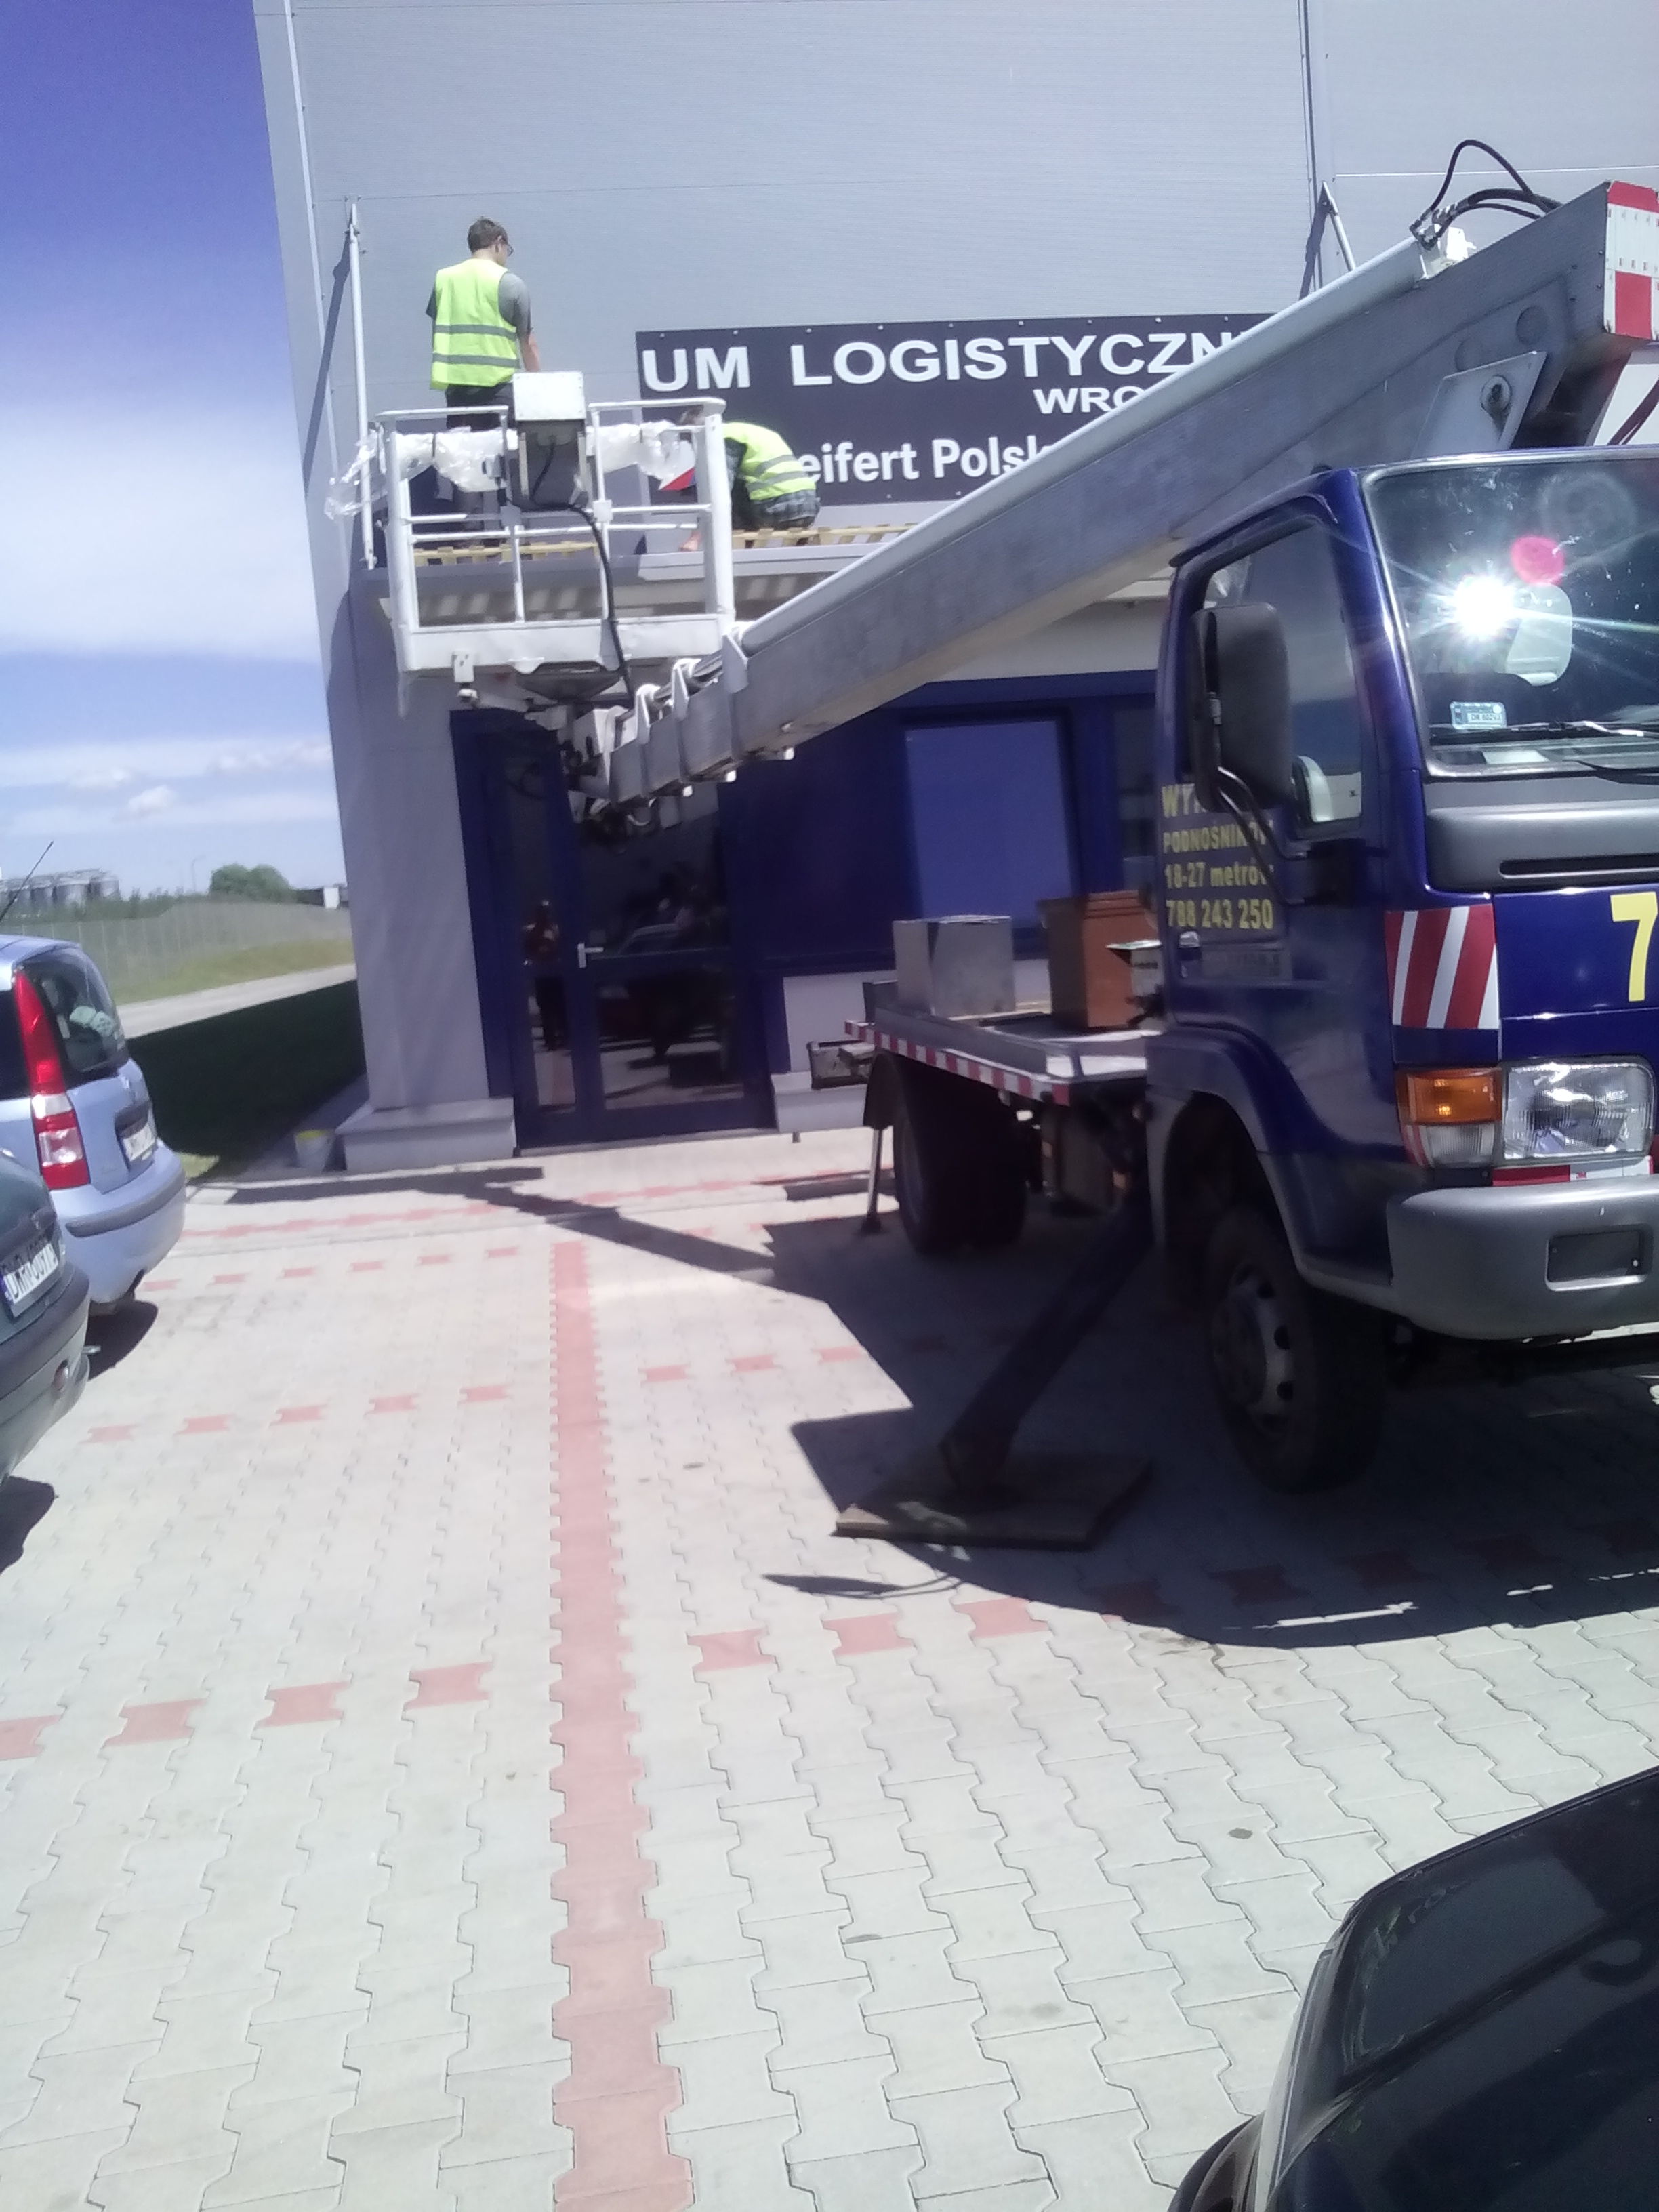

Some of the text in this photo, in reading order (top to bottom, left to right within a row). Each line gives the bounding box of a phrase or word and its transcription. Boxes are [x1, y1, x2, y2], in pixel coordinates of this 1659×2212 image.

[642, 331, 1245, 392] UM LOGISTYCZN
[1033, 386, 1145, 414] WRO
[796, 441, 920, 483] eifert
[1201, 899, 1232, 929] 243
[1238, 899, 1273, 929] 250
[1610, 891, 1658, 1002] 7
